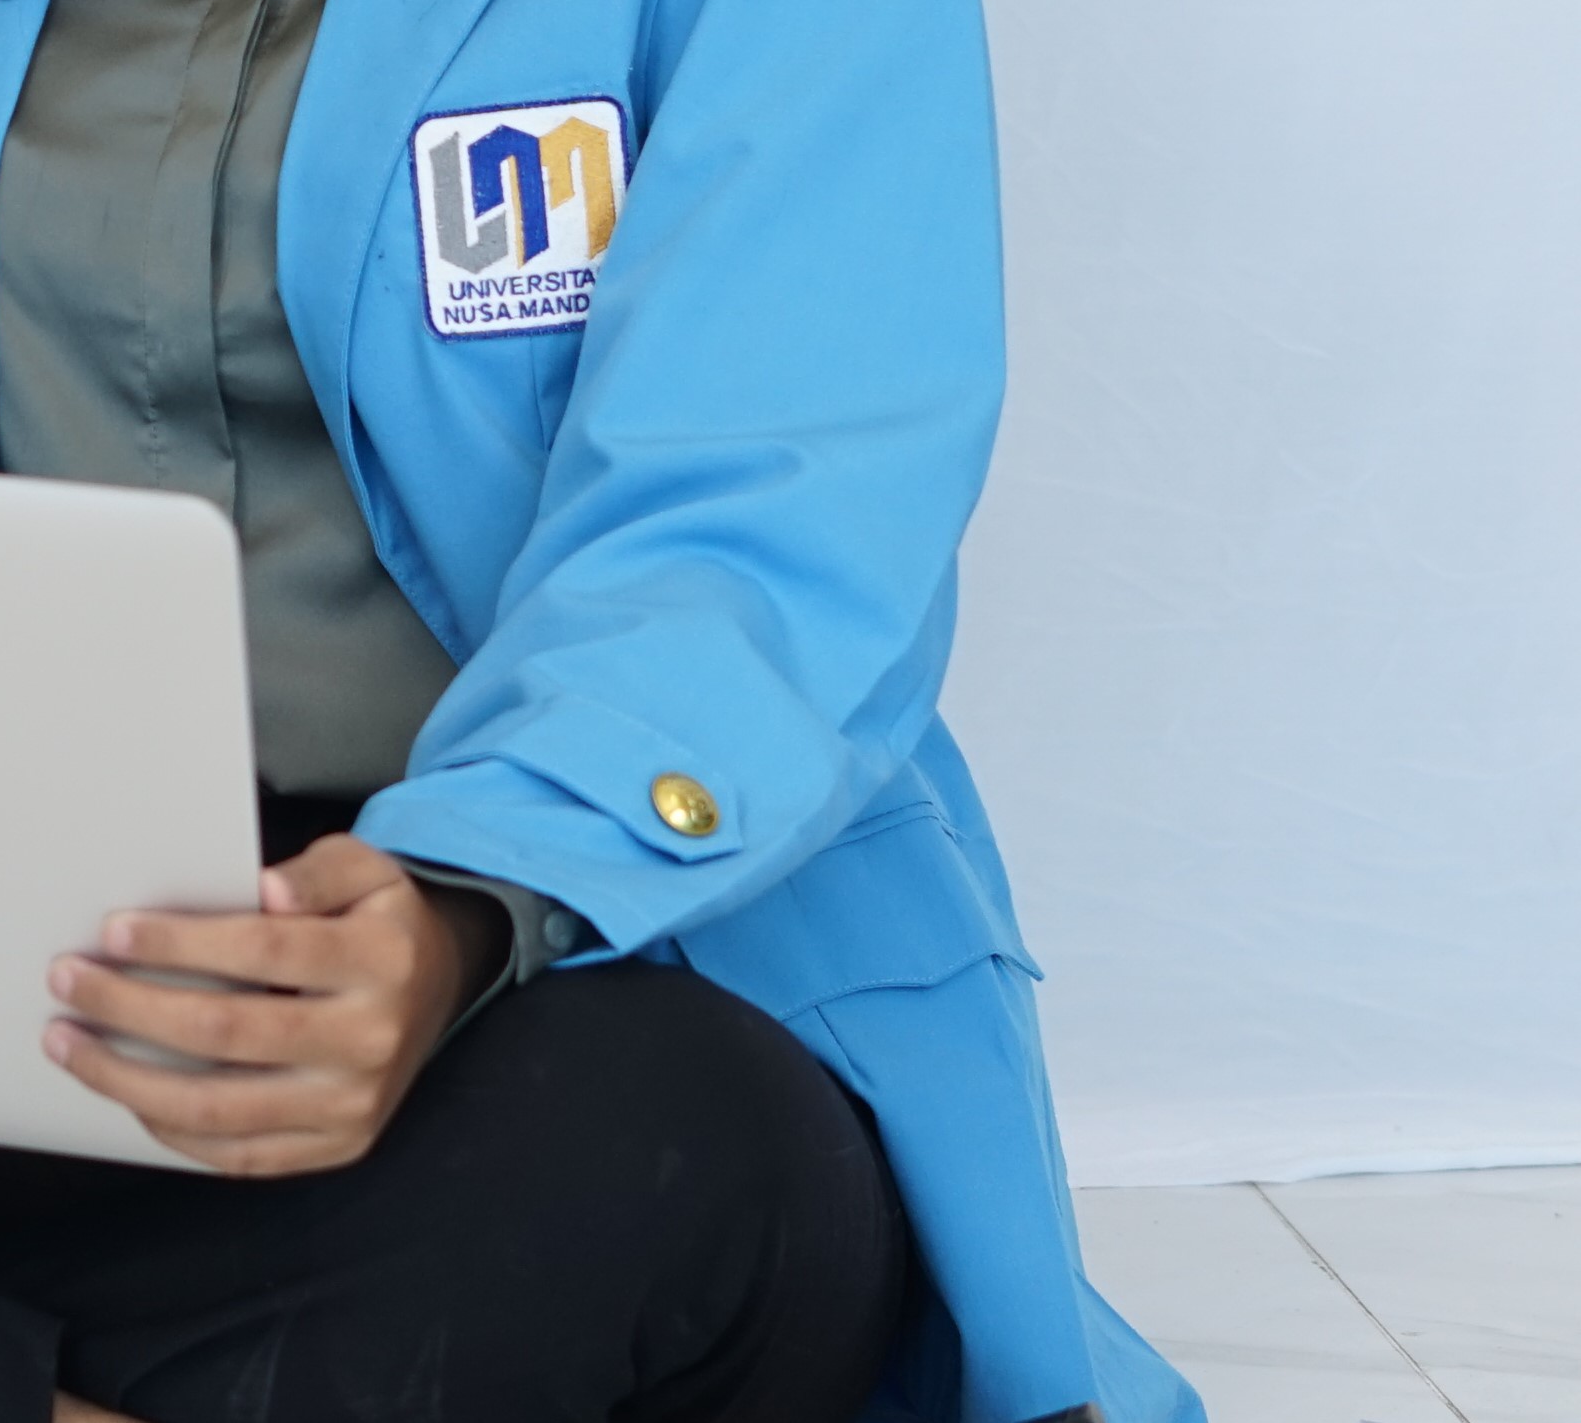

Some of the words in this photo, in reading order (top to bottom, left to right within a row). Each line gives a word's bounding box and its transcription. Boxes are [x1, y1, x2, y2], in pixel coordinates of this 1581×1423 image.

[448, 267, 599, 302] UNIVERSITA
[443, 302, 511, 325] NUSA
[518, 293, 590, 319] MAND
